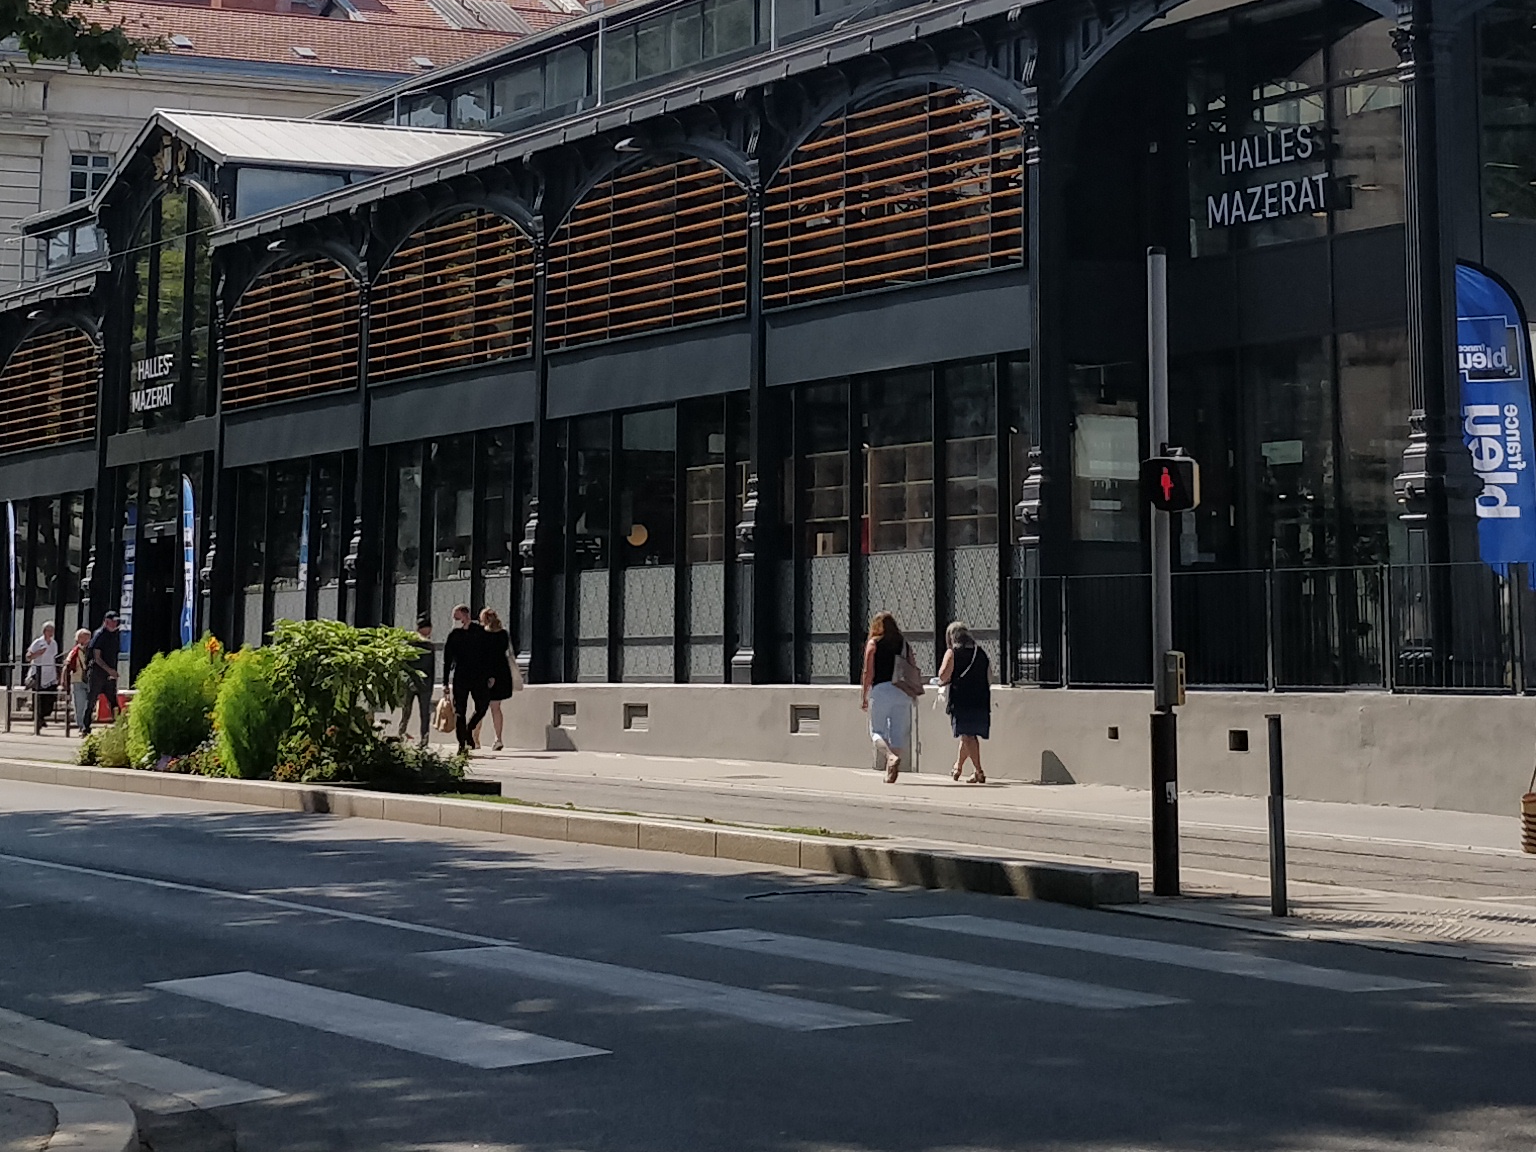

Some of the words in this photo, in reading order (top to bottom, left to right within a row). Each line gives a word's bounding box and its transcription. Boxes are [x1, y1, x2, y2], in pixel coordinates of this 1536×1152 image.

[1220, 124, 1313, 175] HALLES
[1207, 171, 1329, 229] MAZERAT
[137, 355, 170, 381] HALLES
[131, 383, 174, 413] MAZERAT
